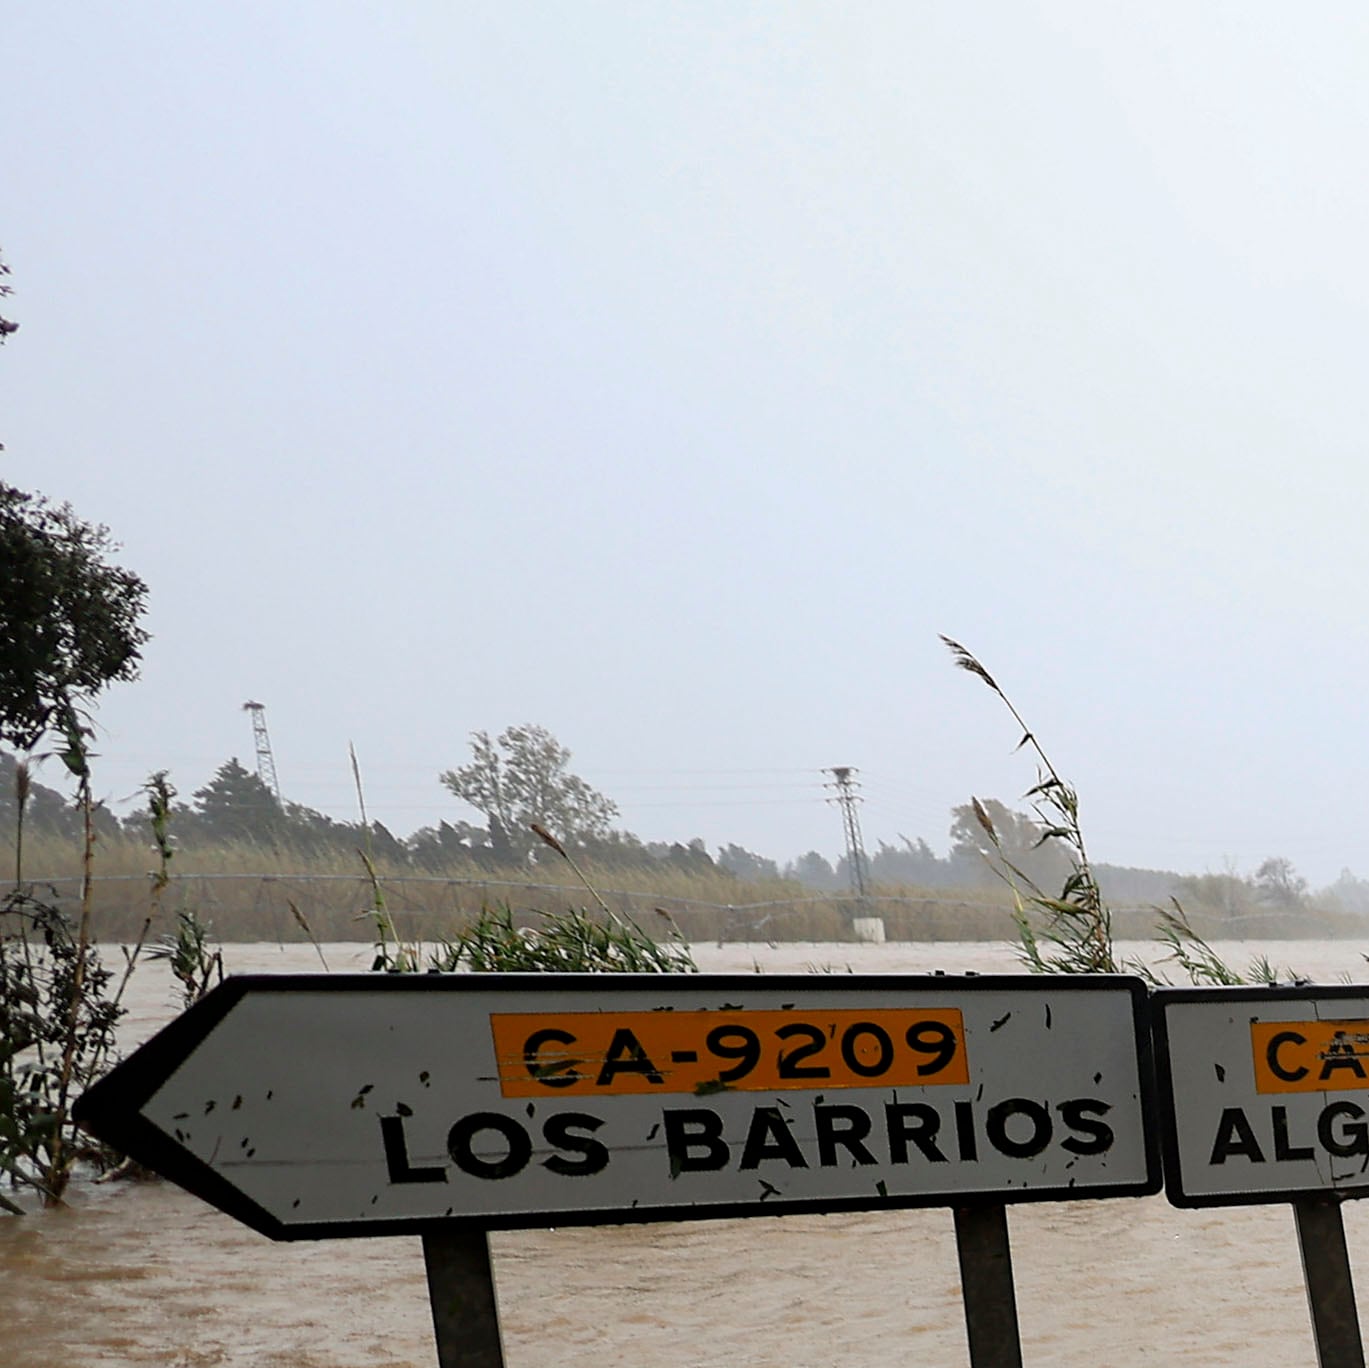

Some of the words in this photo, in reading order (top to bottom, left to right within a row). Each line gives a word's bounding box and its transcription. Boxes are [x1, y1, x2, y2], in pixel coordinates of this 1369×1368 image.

[522, 1020, 956, 1089] CA-9209
[380, 1112, 610, 1184] LOS
[662, 1097, 1114, 1174] BARRIOS
